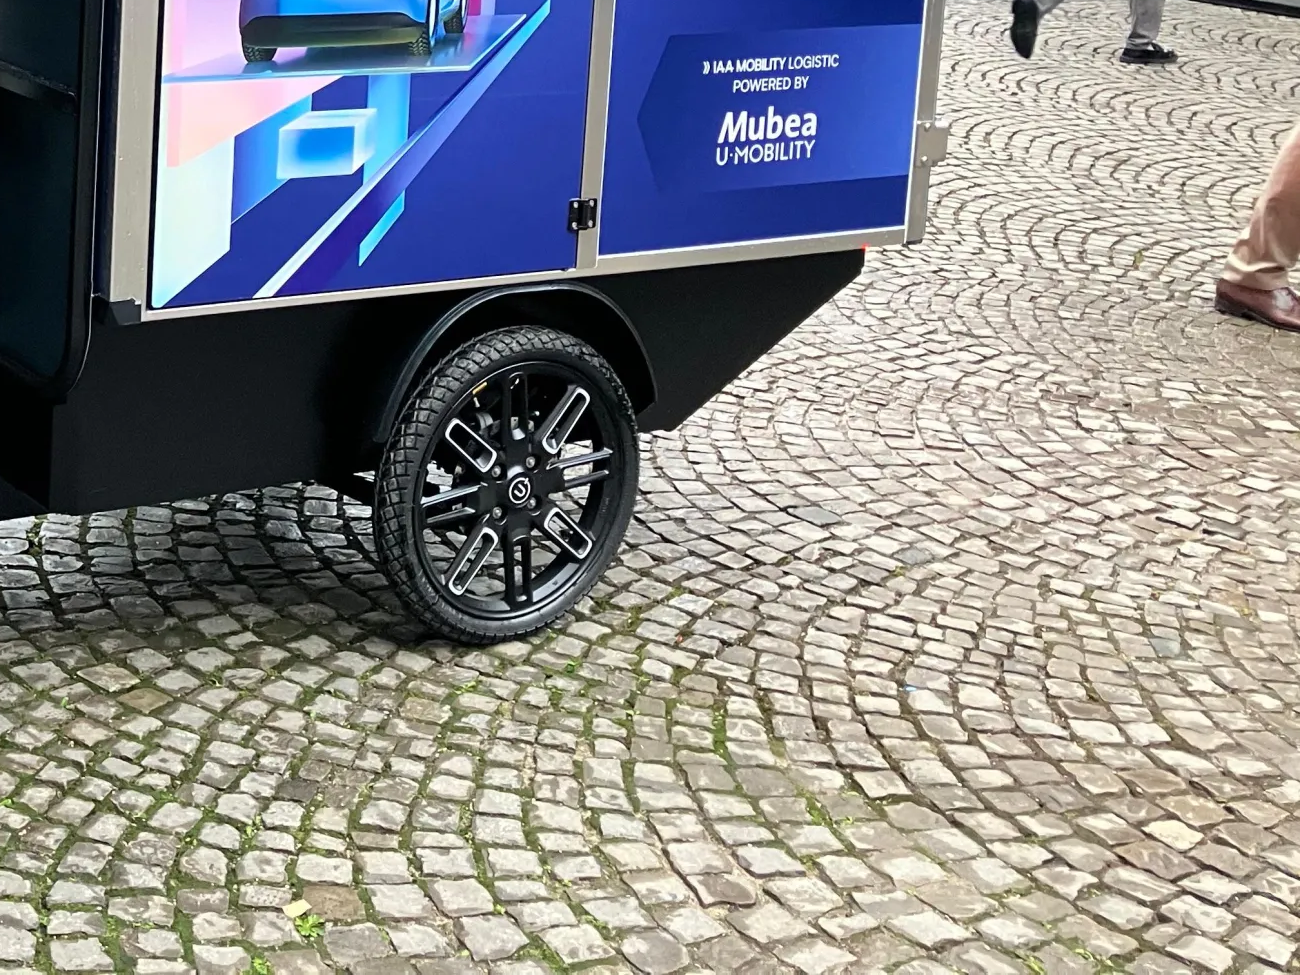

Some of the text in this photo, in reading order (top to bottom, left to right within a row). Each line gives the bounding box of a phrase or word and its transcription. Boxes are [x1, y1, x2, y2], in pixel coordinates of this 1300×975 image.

[713, 54, 840, 74] IAA MOBILITY LOGISTIC
[732, 75, 810, 94] POWERED BY
[717, 105, 818, 144] Mubea
